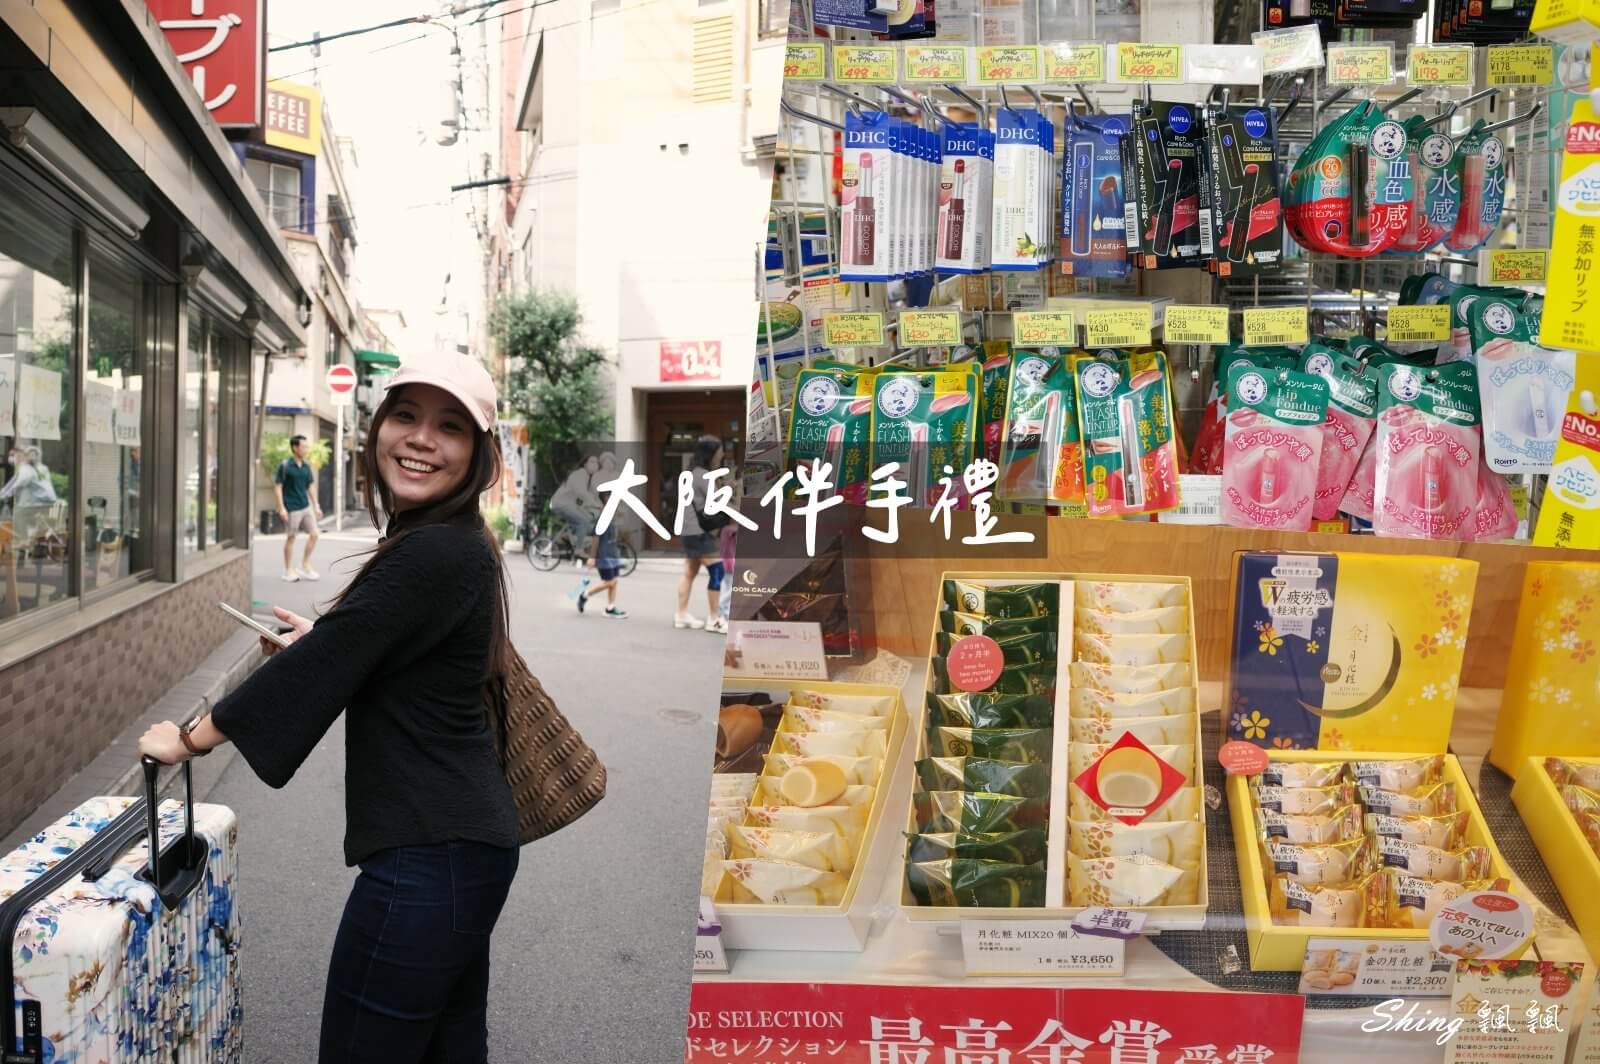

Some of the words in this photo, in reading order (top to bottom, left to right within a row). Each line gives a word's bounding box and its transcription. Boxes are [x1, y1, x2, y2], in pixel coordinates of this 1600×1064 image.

[1490, 62, 1510, 71] ¥178
[1170, 116, 1189, 124] NIVEA
[848, 131, 885, 143] DHC
[1000, 128, 1035, 140] DHC
[947, 140, 976, 151] DHC
[1383, 157, 1411, 229] 血色感
[1429, 168, 1459, 224] 水感
[1482, 171, 1505, 223] 水感
[1571, 224, 1596, 313] 無添加リップ
[1090, 324, 1109, 332] ¥430
[1167, 320, 1187, 329] ¥528
[1247, 322, 1266, 332] ¥528
[1390, 319, 1410, 329] ¥528
[1023, 328, 1047, 341] 430
[1277, 389, 1297, 401] Lip
[1276, 400, 1321, 413] Fondue
[1086, 407, 1118, 421] FLASH
[795, 427, 826, 441] FLASH
[877, 430, 910, 441] FLASH
[1494, 458, 1518, 466] ROHTO
[785, 660, 820, 671] ¥1,620
[1090, 914, 1133, 929] 半額
[1438, 907, 1527, 938] 元気でいてほしい
[1448, 925, 1498, 945] あの人へ
[1071, 955, 1114, 965] ¥3,650
[1405, 976, 1447, 985] ¥2,300
[718, 1011, 845, 1028] SELECTION
[686, 1036, 848, 1059] ドセレクション
